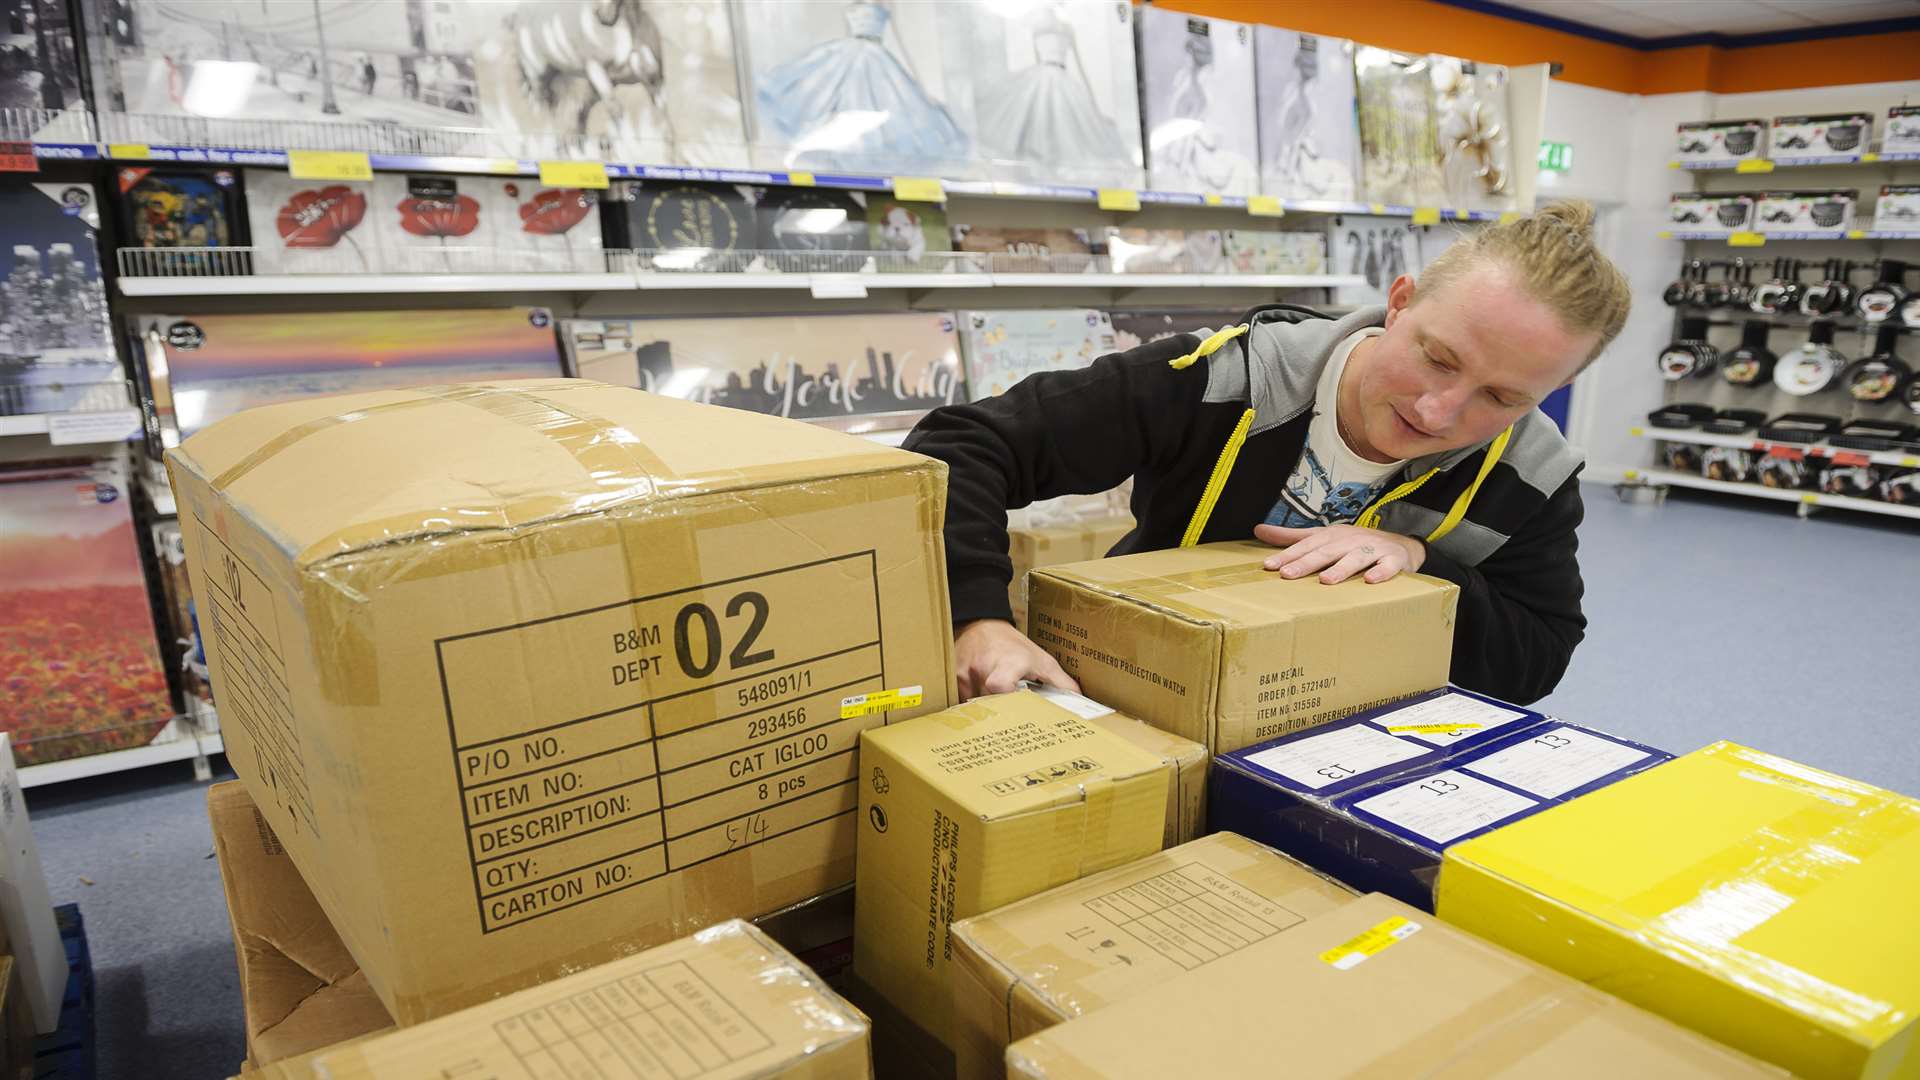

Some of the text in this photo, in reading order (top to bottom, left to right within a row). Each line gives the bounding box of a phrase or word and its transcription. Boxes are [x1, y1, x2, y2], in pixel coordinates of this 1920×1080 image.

[613, 625, 662, 653] B&M
[673, 591, 775, 678] 02
[611, 655, 662, 686] DEPT
[1081, 645, 1119, 669] SUPERHERO
[1120, 660, 1162, 685] PROJECTION
[1163, 679, 1186, 696] WATCH
[1259, 672, 1278, 686] B&M
[738, 670, 812, 707] 548091/1
[1258, 688, 1286, 703] ORDER
[1301, 677, 1336, 694] 572140/1
[747, 707, 807, 739] 293456
[1257, 706, 1277, 720] ITEM
[1293, 697, 1321, 712] 315568
[1312, 705, 1357, 725] SUPERHERO
[467, 737, 565, 776] P/O NO.
[729, 733, 828, 778] CAT IGLOO
[1535, 734, 1571, 750] 13
[758, 775, 806, 800] 8 pcs
[1317, 763, 1356, 780] 13
[1420, 779, 1460, 796] 13
[473, 772, 583, 815] ITEM NO:
[479, 795, 631, 852] DESCRIPTION:
[929, 809, 942, 895] PRODUCTION
[949, 821, 960, 873] PHILIPS
[486, 859, 538, 887] QTY:
[491, 864, 632, 921] CARTON NO:
[928, 895, 938, 932] DATE
